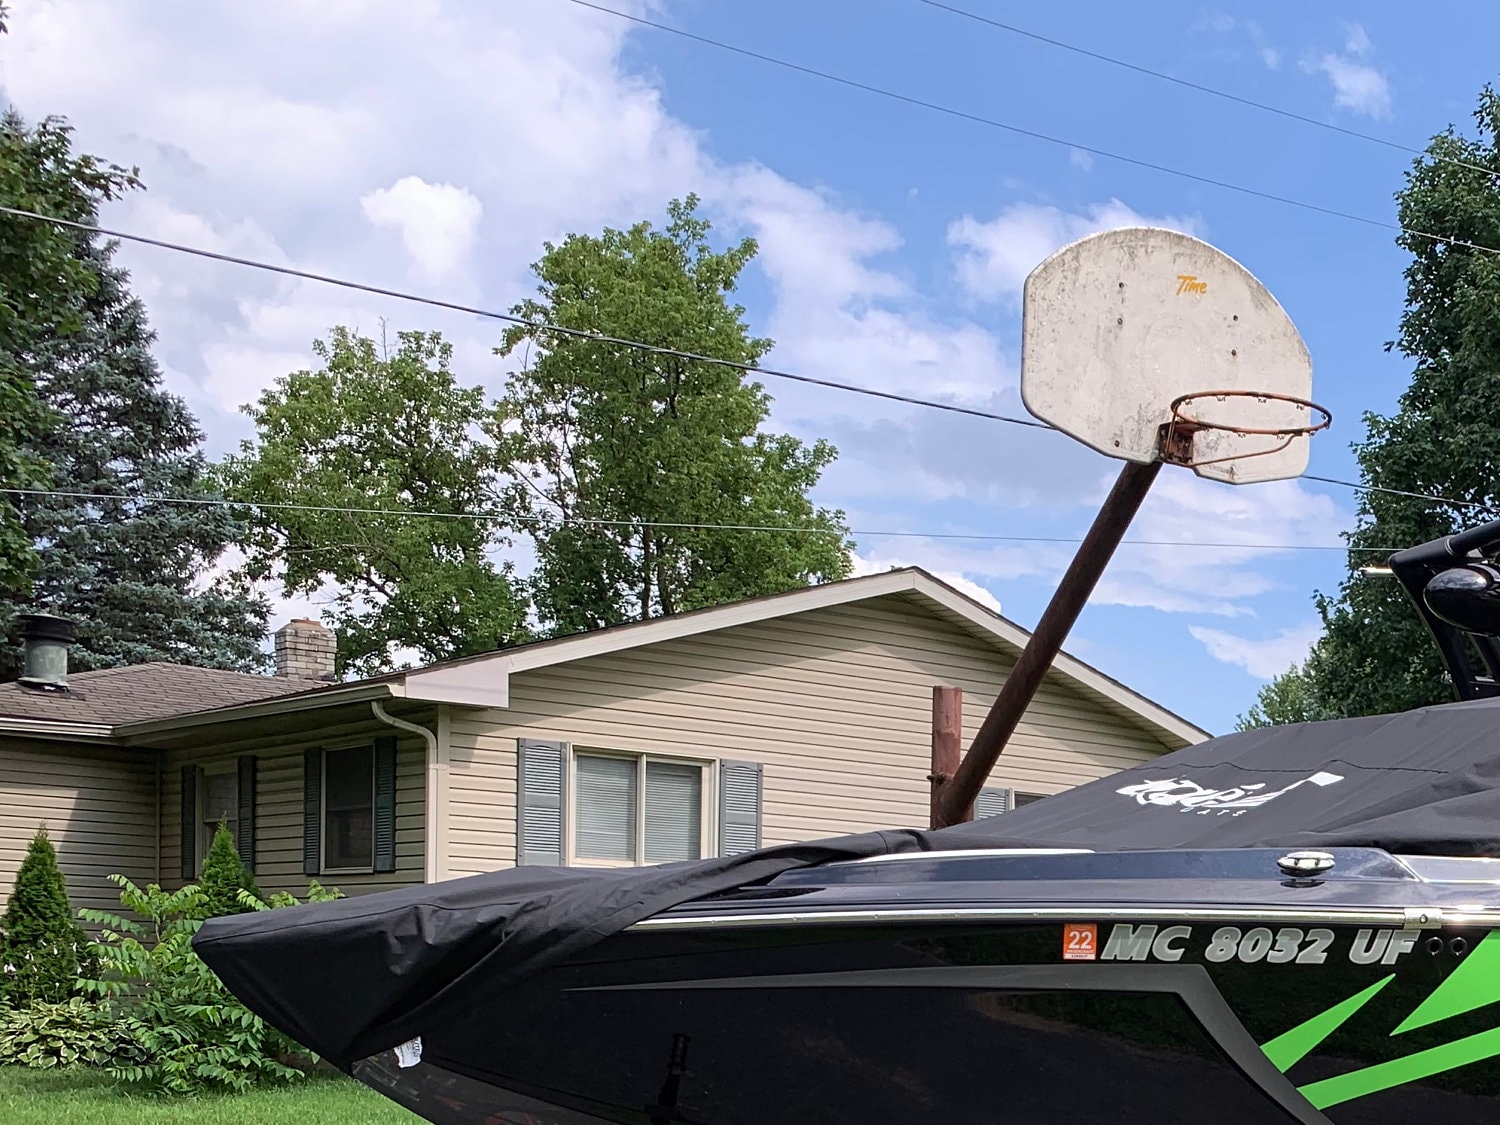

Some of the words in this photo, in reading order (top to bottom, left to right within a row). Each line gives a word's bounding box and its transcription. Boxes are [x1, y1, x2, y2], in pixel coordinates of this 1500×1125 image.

[1068, 930, 1093, 950] 22
[1100, 924, 1192, 961] MC
[1204, 926, 1336, 963] 8032
[1349, 929, 1420, 965] UF
